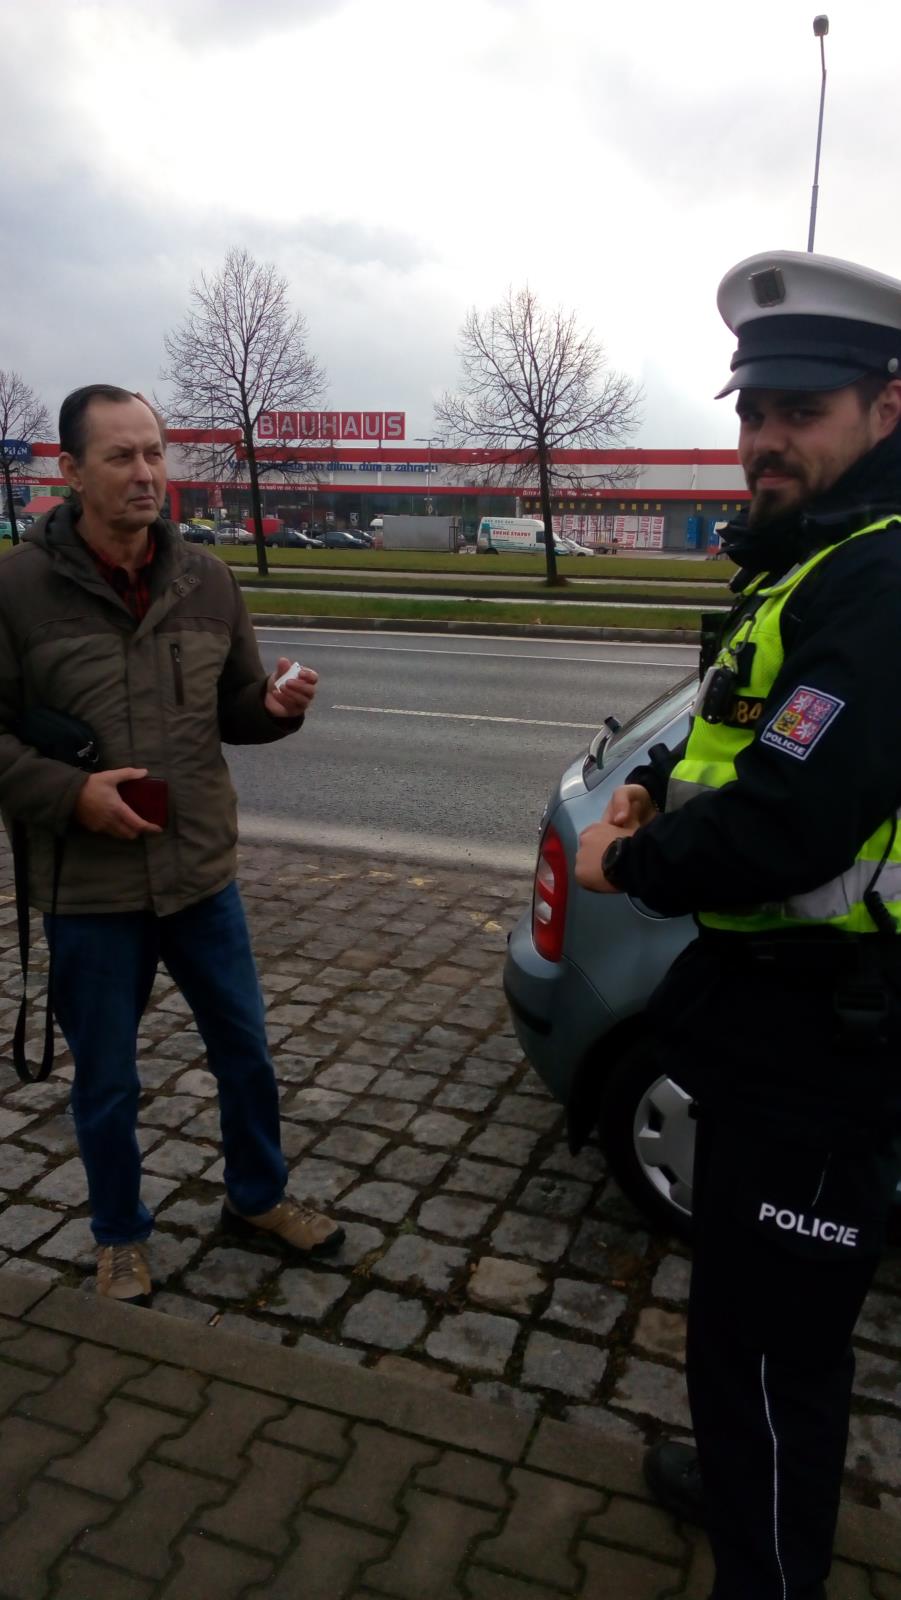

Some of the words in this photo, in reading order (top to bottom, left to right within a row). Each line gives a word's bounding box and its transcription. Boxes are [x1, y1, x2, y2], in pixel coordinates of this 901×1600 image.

[259, 414, 402, 436] BAUHAUS
[385, 464, 392, 472] a
[732, 700, 763, 724] 84
[765, 731, 807, 756] POLICIE
[758, 1202, 859, 1247] POLICIE
